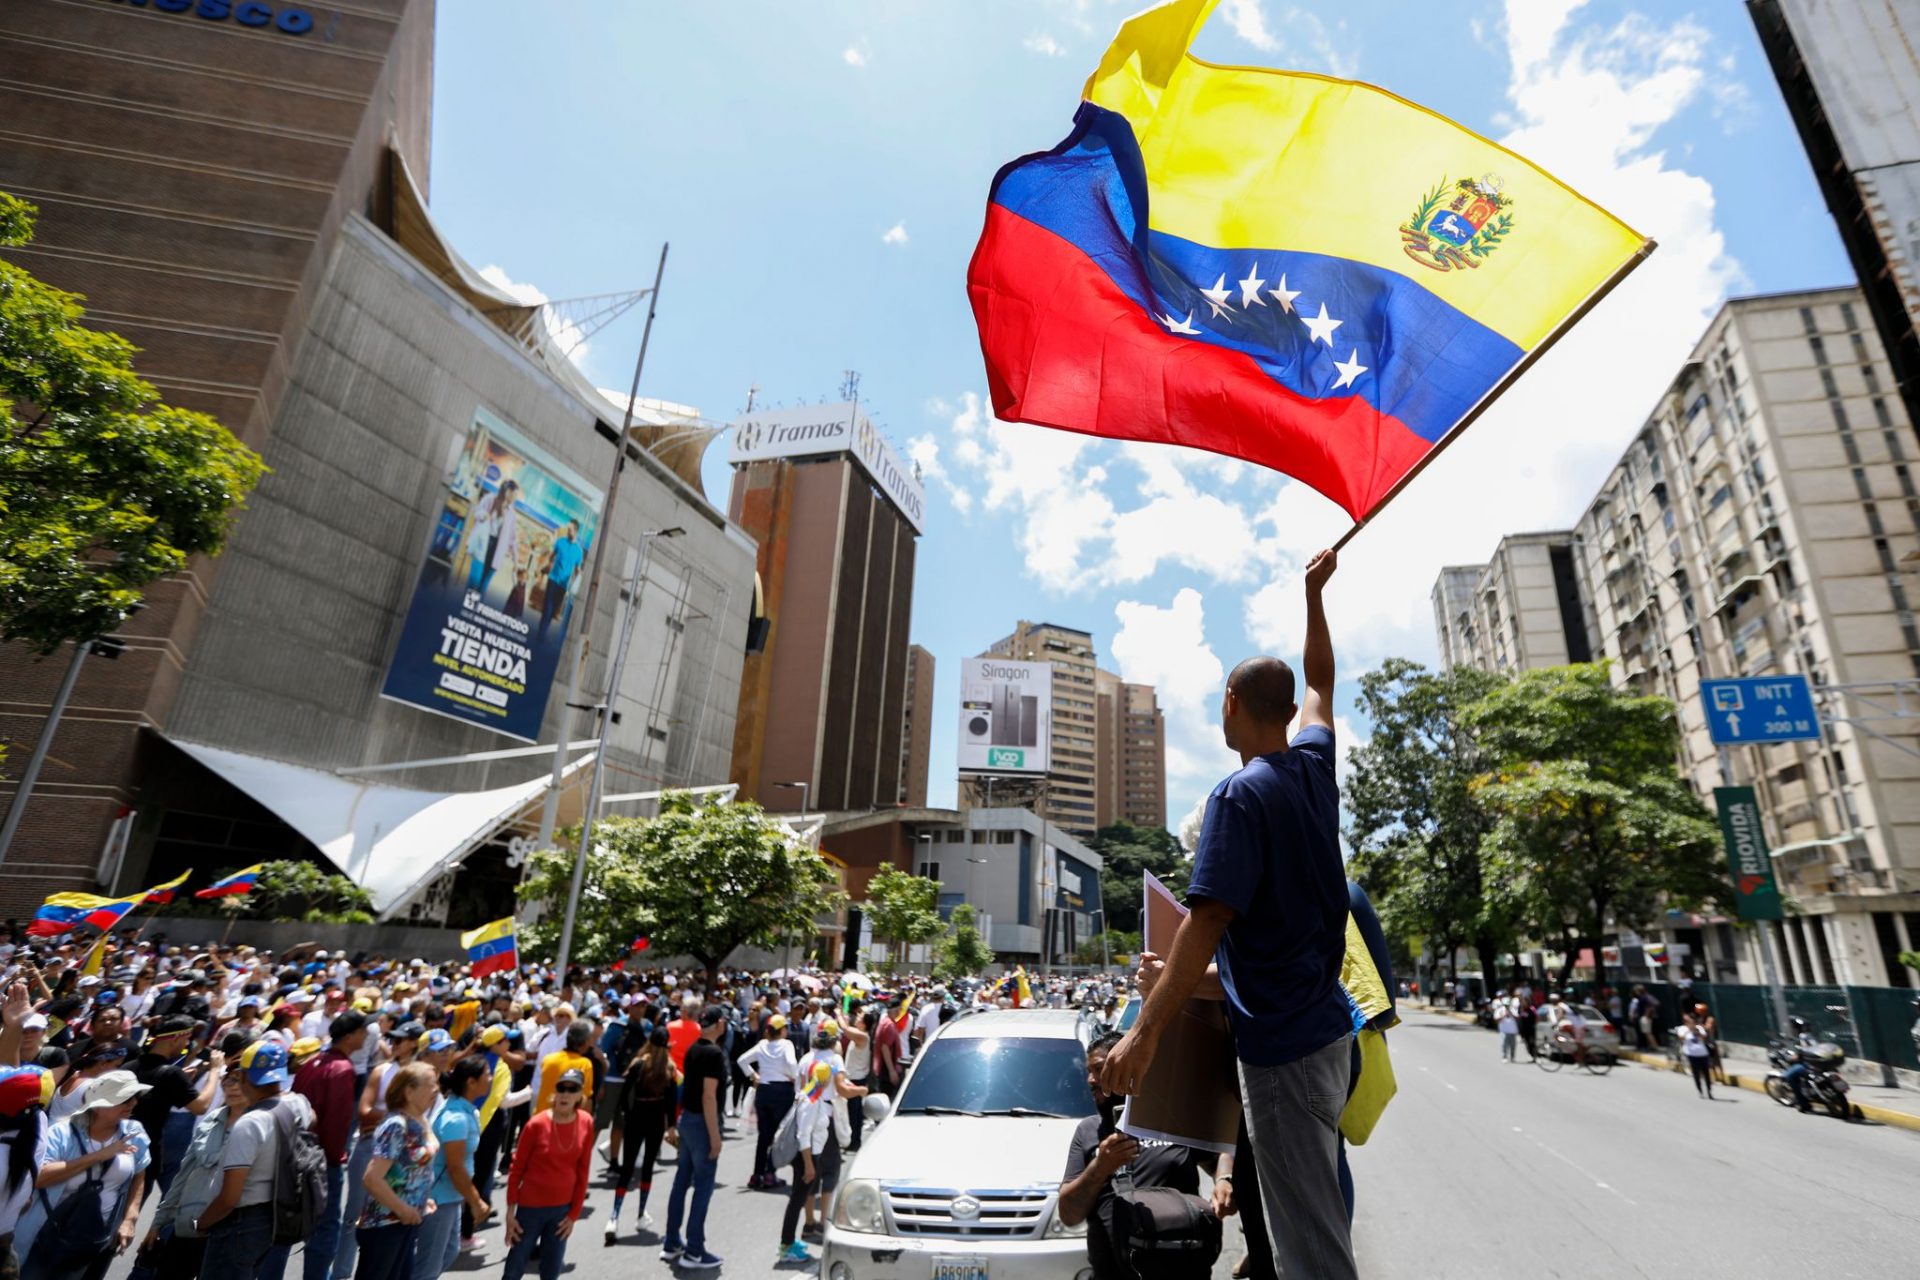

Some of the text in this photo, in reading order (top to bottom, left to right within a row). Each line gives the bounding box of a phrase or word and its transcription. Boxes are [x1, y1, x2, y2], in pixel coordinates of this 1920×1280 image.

[767, 420, 846, 444] Tramas
[875, 438, 921, 521] Tramas
[447, 615, 482, 641] VISITA
[483, 632, 532, 661] NUESTRA
[441, 628, 527, 685] TIENDA
[1754, 684, 1792, 700] INTT
[1765, 720, 1810, 734] 300 M
[1775, 704, 1787, 716] A
[1728, 802, 1759, 875] RIOVIDA
